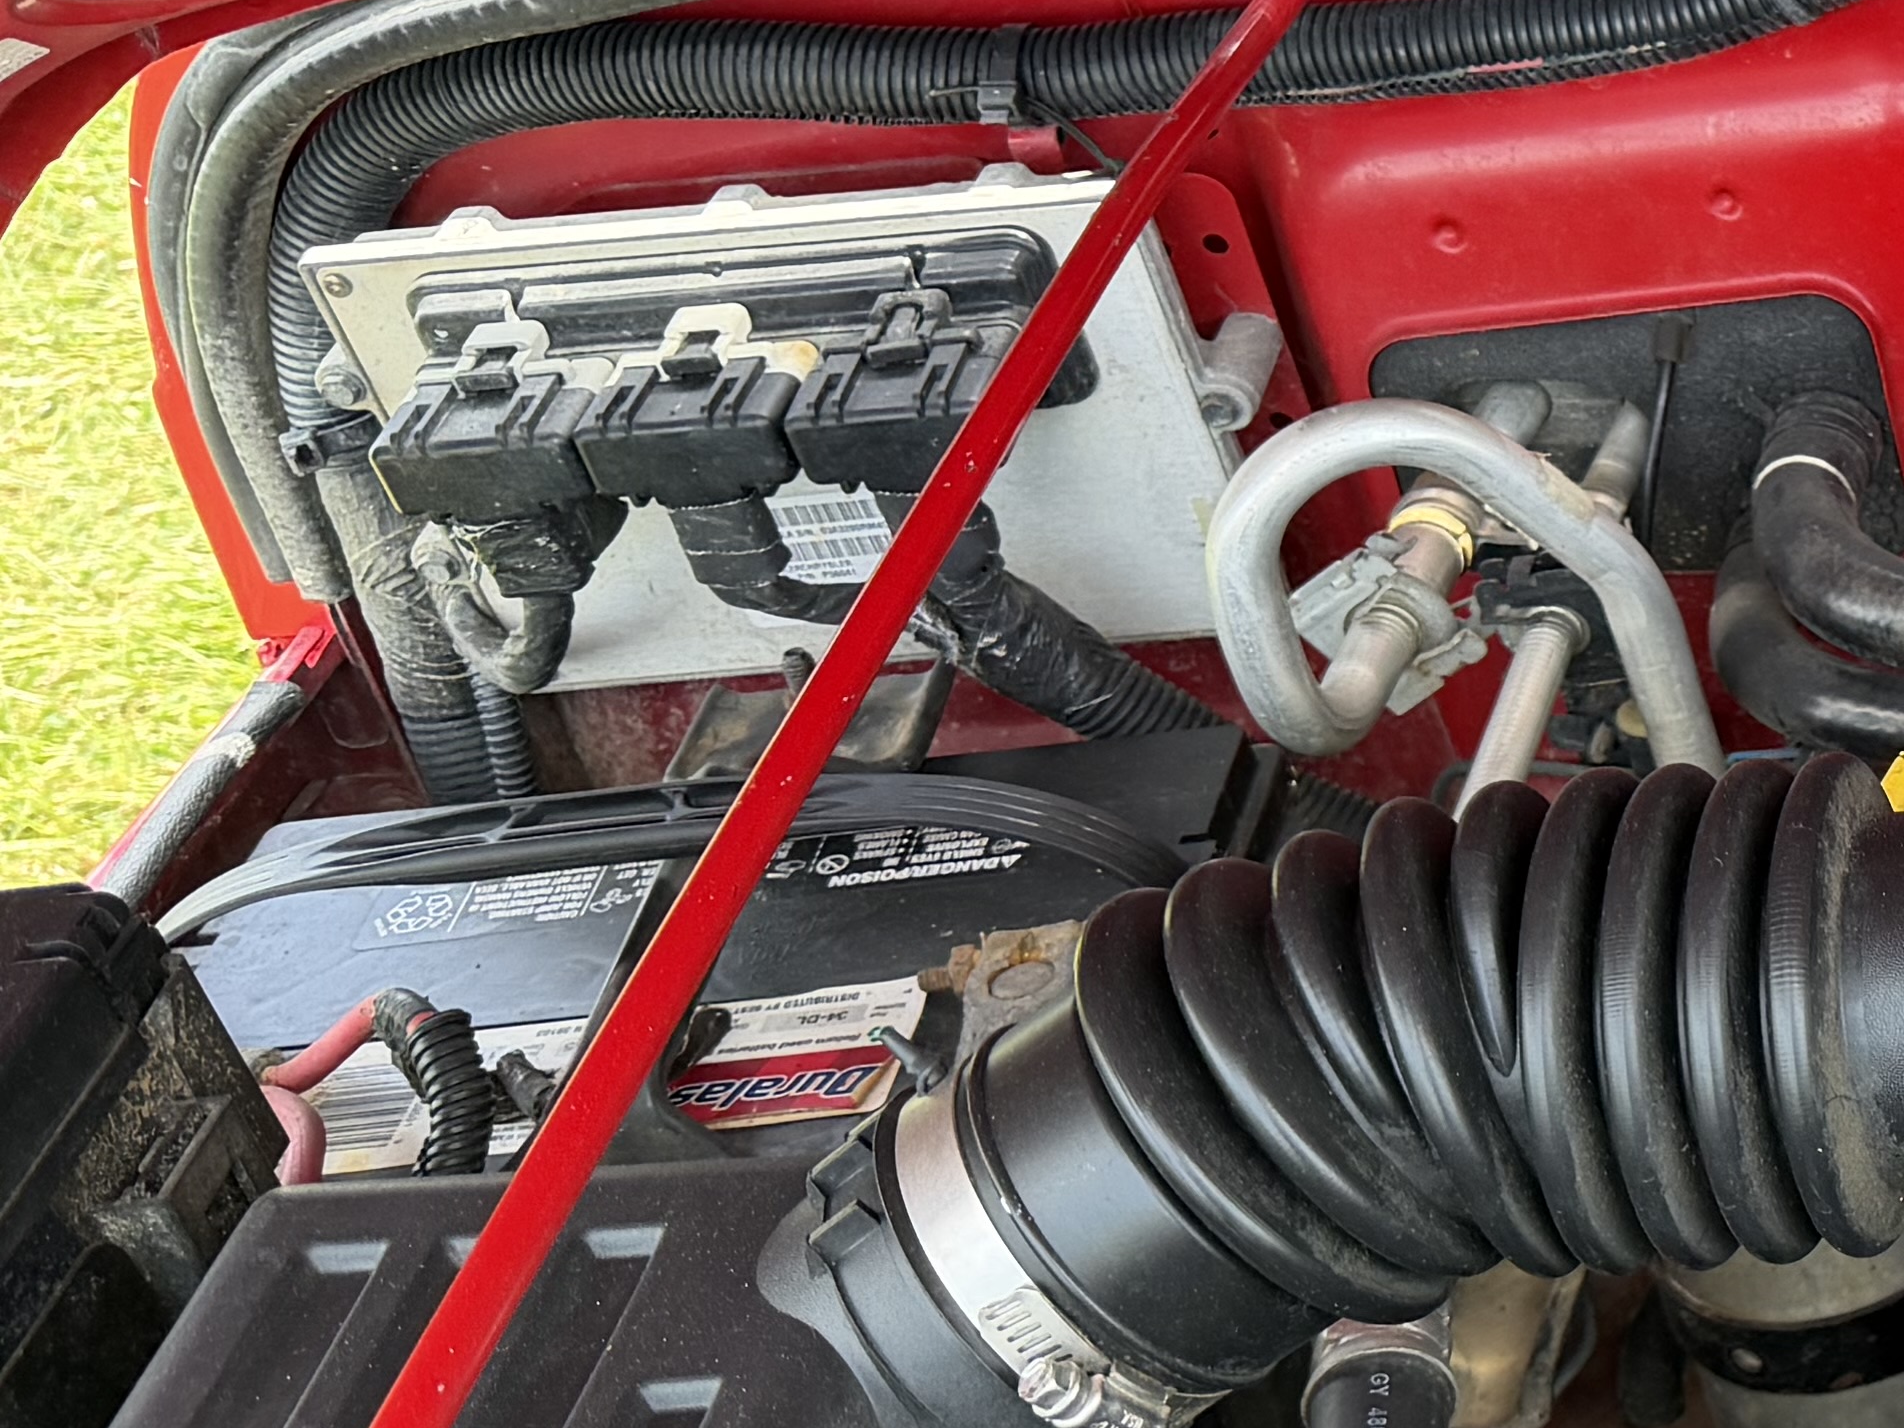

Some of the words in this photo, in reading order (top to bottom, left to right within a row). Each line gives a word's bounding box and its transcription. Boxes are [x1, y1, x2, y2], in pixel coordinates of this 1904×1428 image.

[765, 1001, 780, 1011] BY
[783, 992, 860, 1010] DISTRIBUTED
[732, 1003, 763, 1014] BEST
[797, 1009, 849, 1026] 34-DL
[778, 1038, 812, 1050] used
[814, 1032, 861, 1045] Return
[717, 1042, 776, 1055] batteries
[1367, 1371, 1390, 1396] GY
